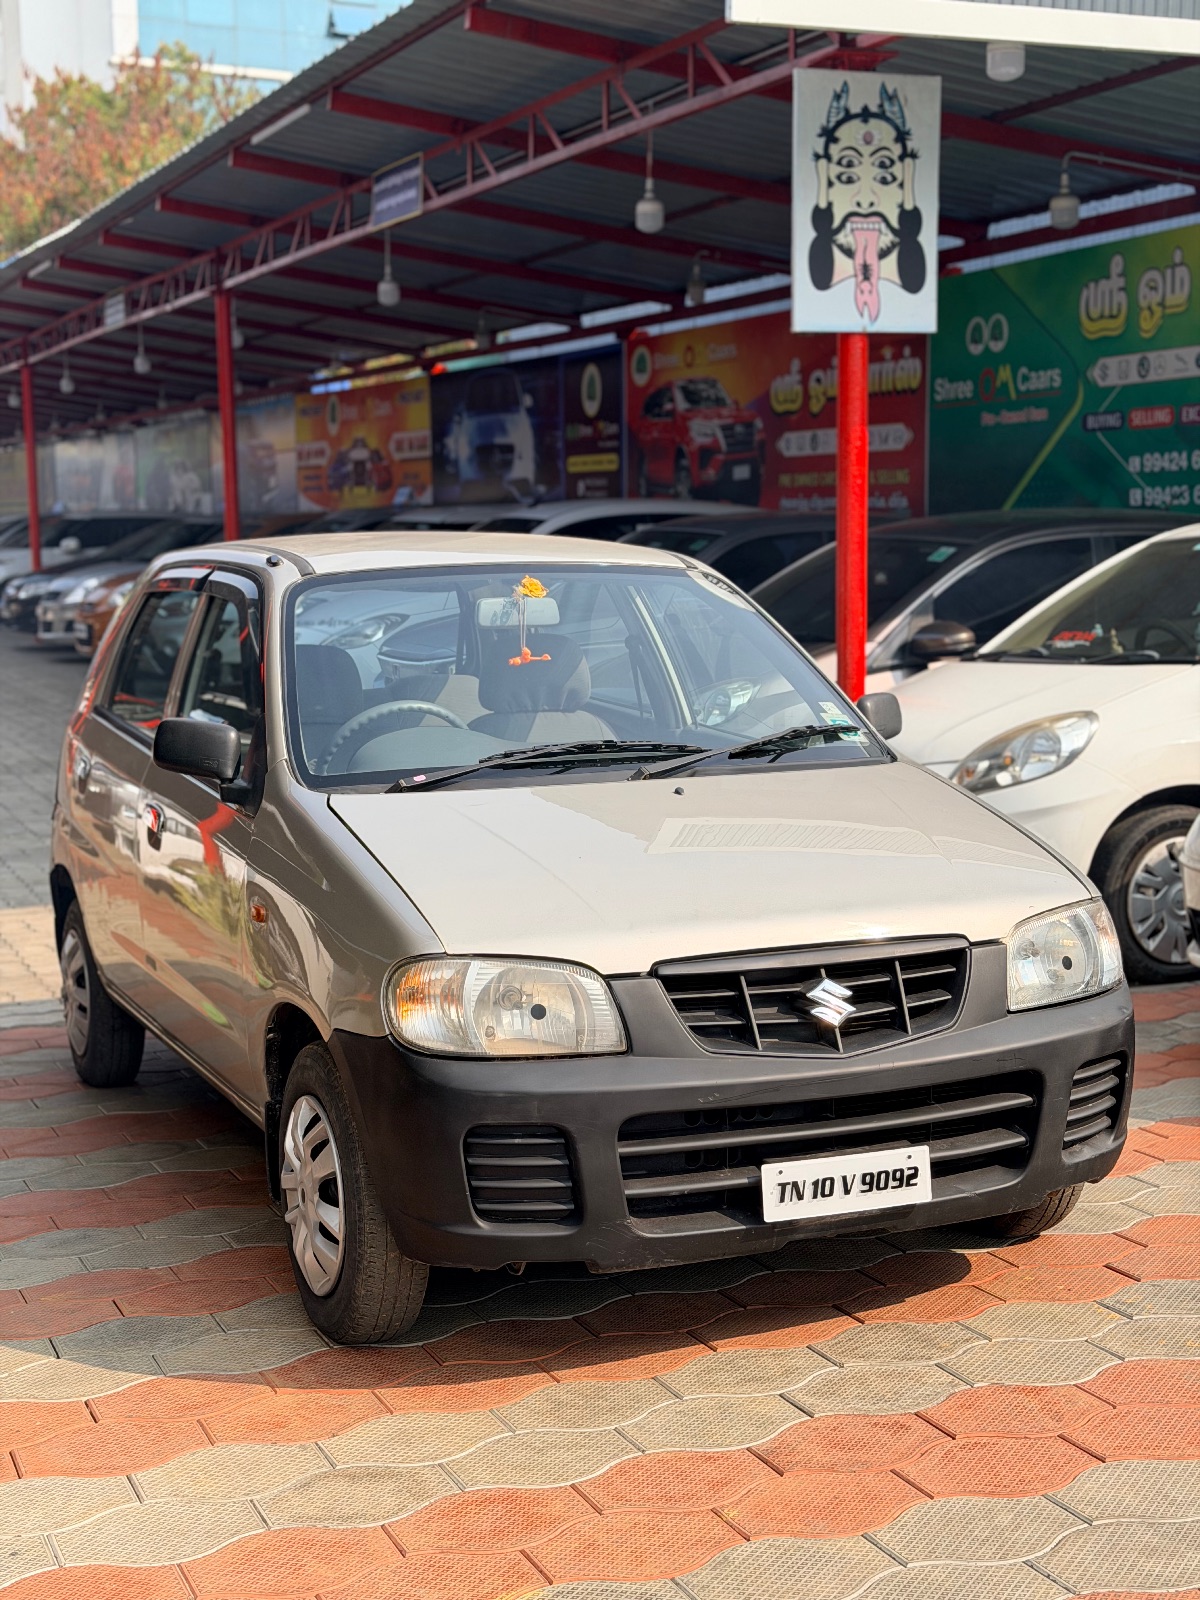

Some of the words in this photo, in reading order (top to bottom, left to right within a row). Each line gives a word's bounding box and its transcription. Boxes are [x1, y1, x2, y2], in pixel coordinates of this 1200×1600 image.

[1138, 247, 1191, 338] ஓம்
[934, 377, 974, 402] Shree
[1016, 366, 1062, 392] Caars
[1087, 411, 1122, 430] BUYING
[1131, 407, 1172, 427] SELLING
[1143, 450, 1188, 473] 99424
[777, 1180, 806, 1203] TN
[811, 1176, 835, 1200] 10
[841, 1173, 856, 1196] V
[859, 1165, 919, 1194] 9092
